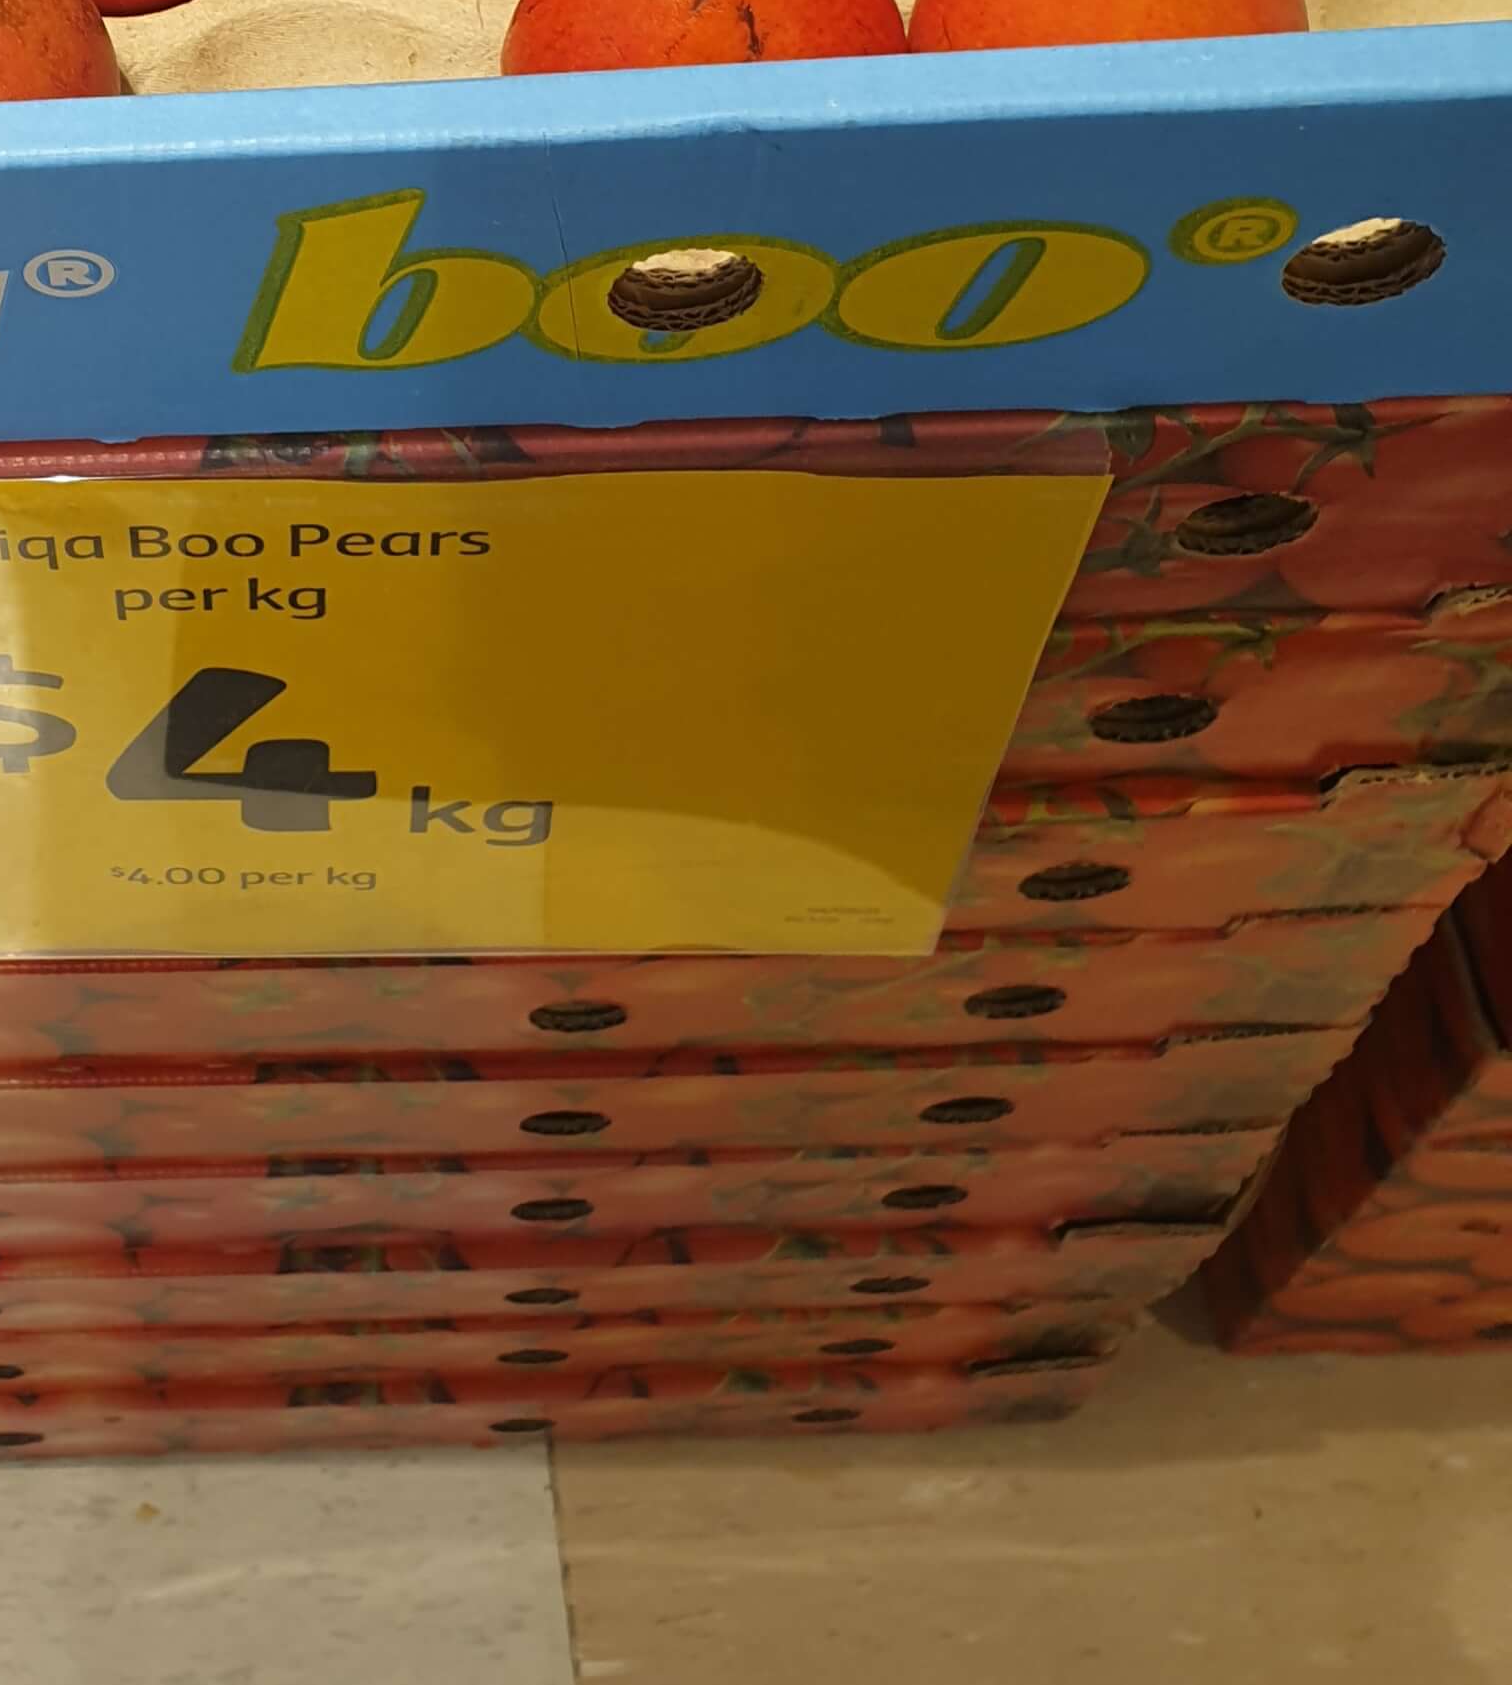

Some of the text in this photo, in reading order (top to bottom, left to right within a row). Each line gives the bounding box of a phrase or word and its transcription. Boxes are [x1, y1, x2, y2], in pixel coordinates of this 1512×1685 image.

[128, 524, 265, 559] Boo
[288, 522, 491, 557] Pears
[114, 577, 327, 620] per kg
[409, 785, 554, 847] kg
[241, 869, 313, 891] per
[327, 866, 378, 891] kg
